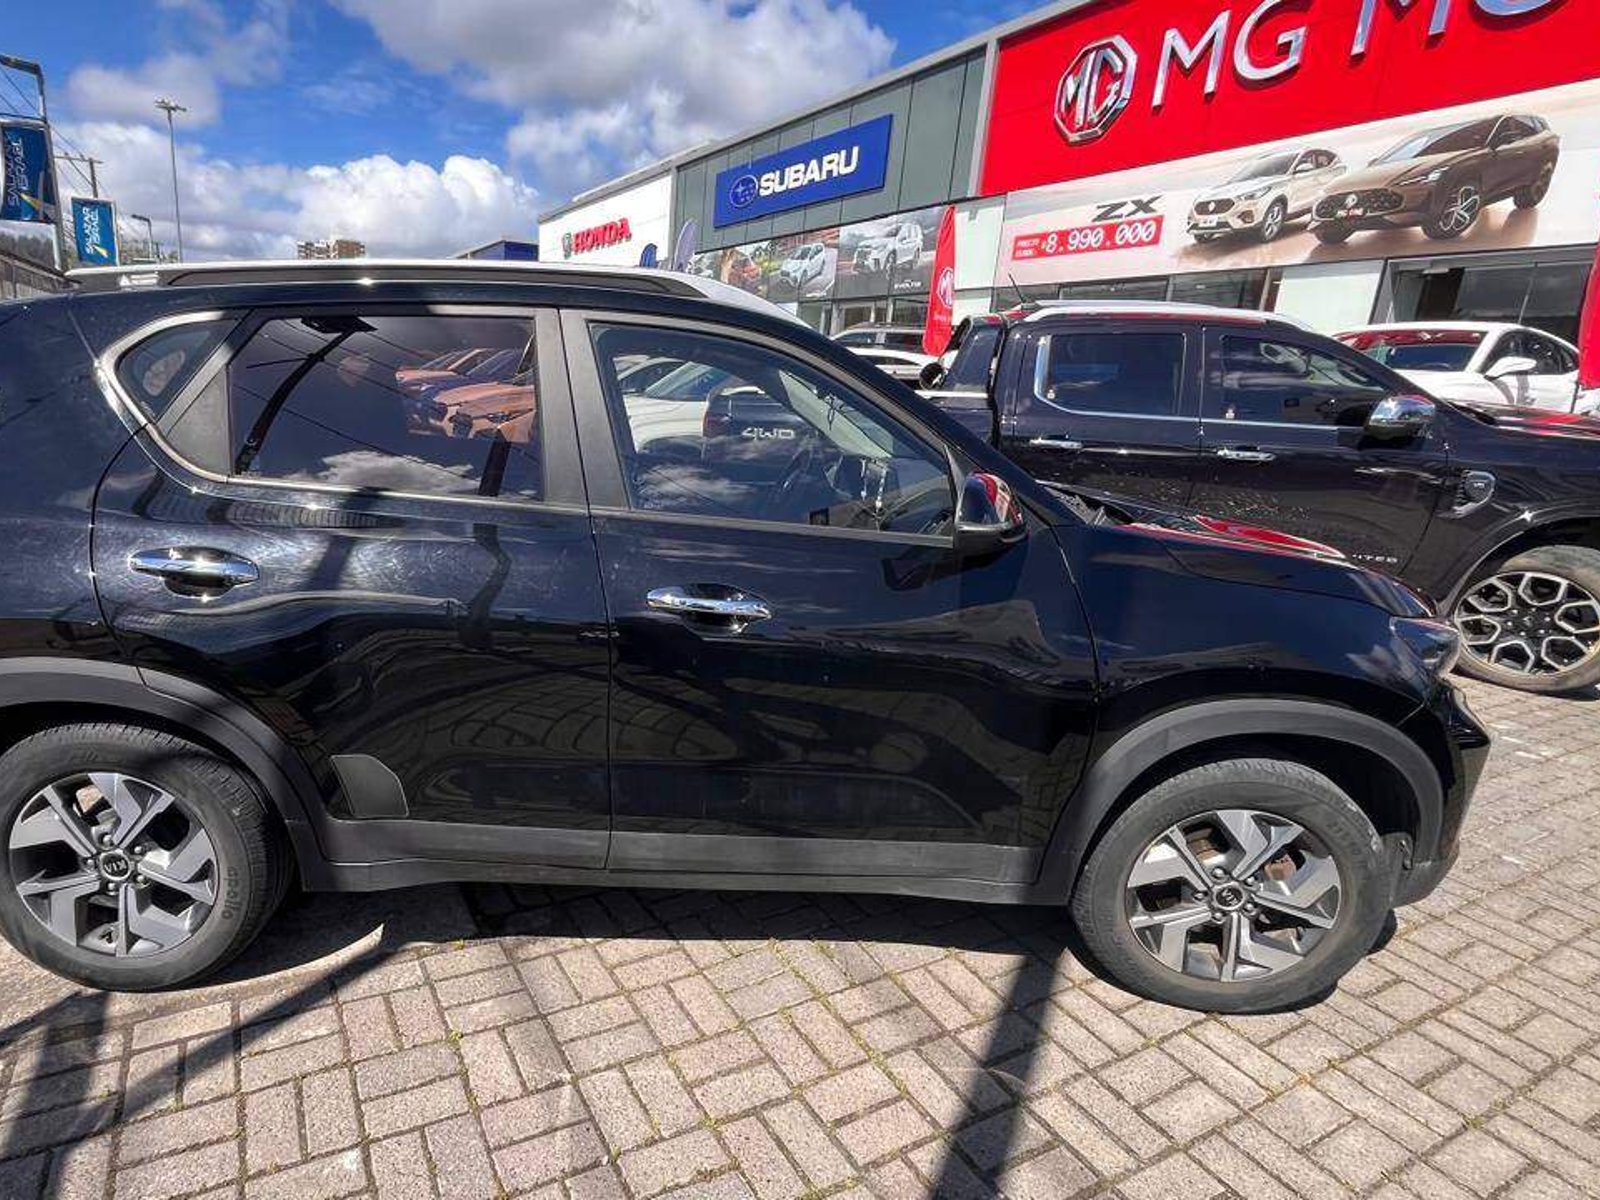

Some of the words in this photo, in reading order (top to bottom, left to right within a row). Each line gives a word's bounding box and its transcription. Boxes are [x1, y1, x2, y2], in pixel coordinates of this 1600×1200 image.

[1151, 0, 1306, 108] MG
[758, 146, 859, 196] SUBARU
[82, 206, 94, 254] SALAZAR
[1091, 195, 1163, 223] ZX
[572, 217, 632, 255] HONDA
[741, 426, 796, 442] 4WD
[103, 858, 128, 873] KIA
[221, 865, 243, 920] apollo
